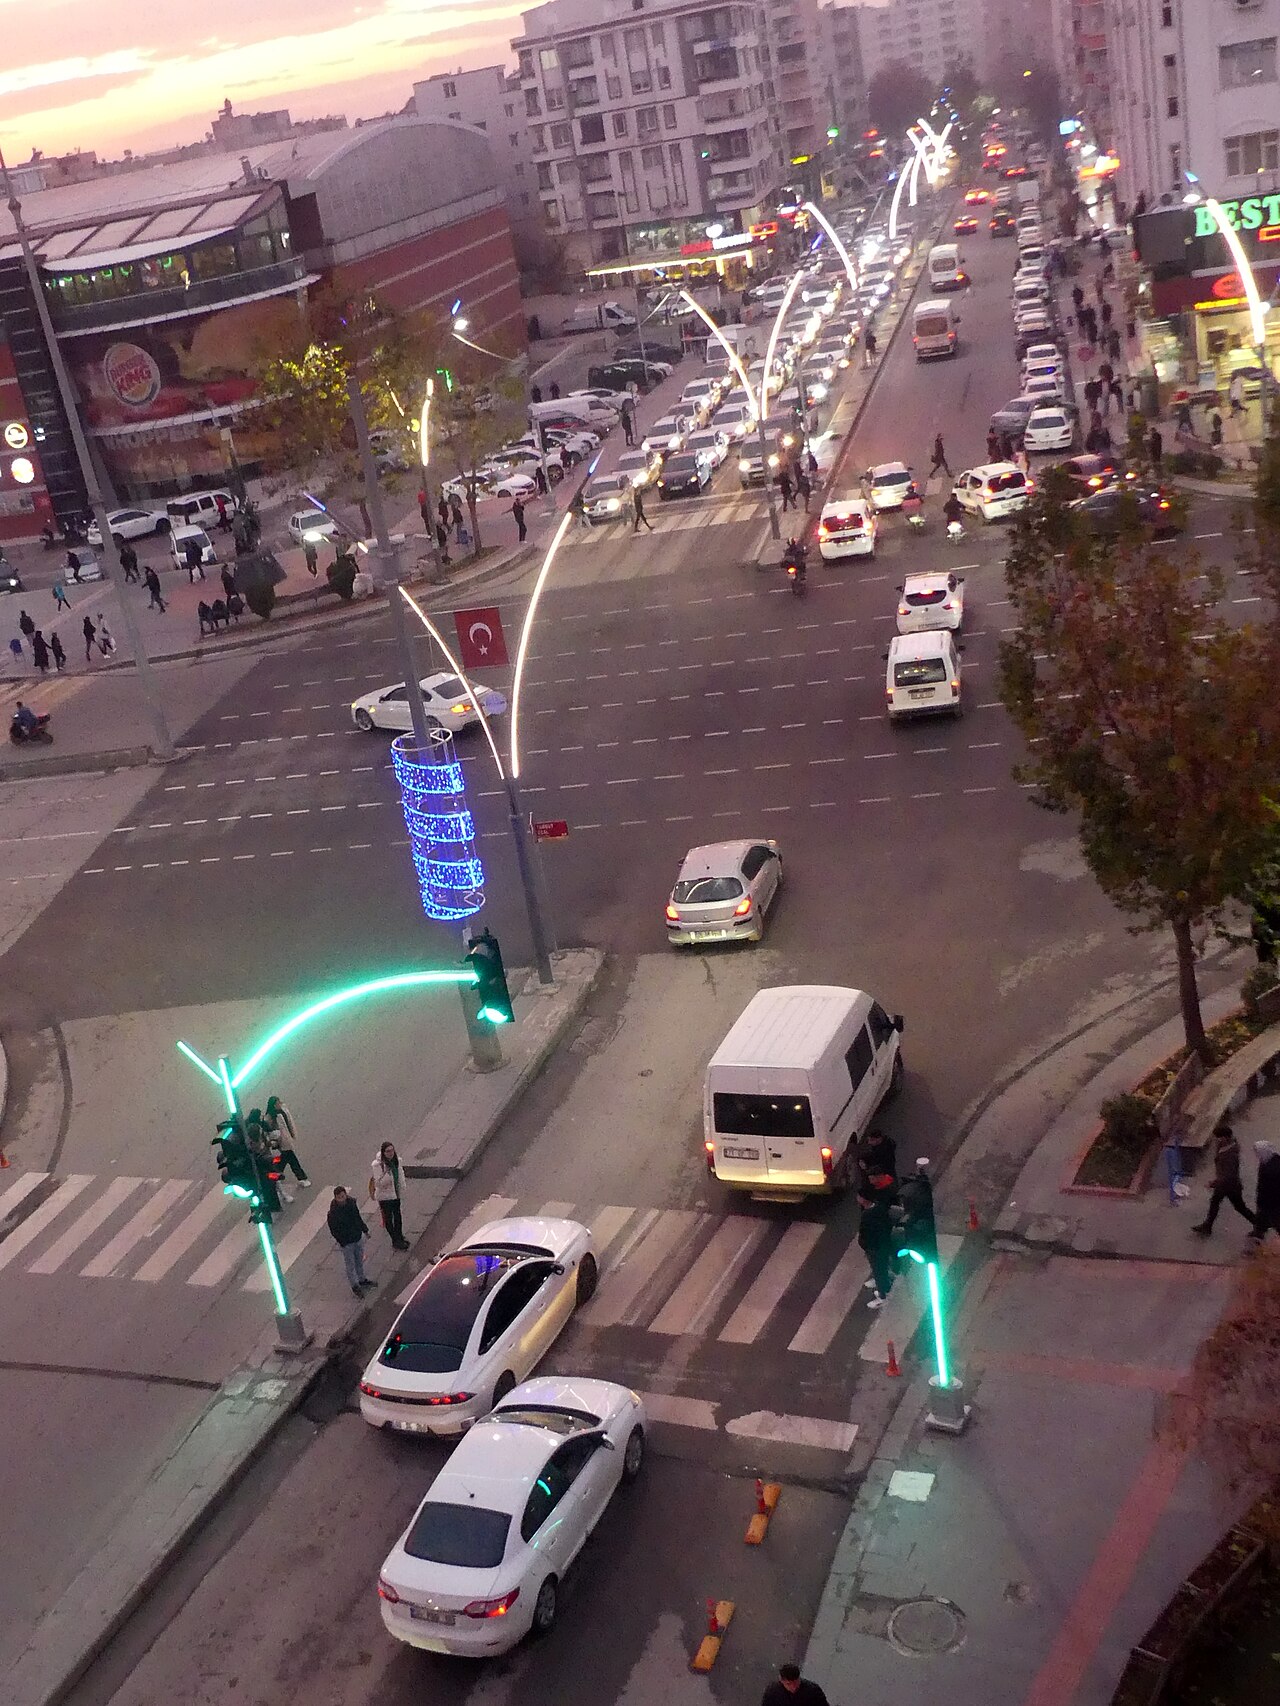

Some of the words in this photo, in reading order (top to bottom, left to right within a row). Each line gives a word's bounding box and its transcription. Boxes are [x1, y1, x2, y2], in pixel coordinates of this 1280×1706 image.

[1194, 195, 1280, 237] BEST
[110, 354, 147, 383] BURGER
[116, 367, 152, 395] KING
